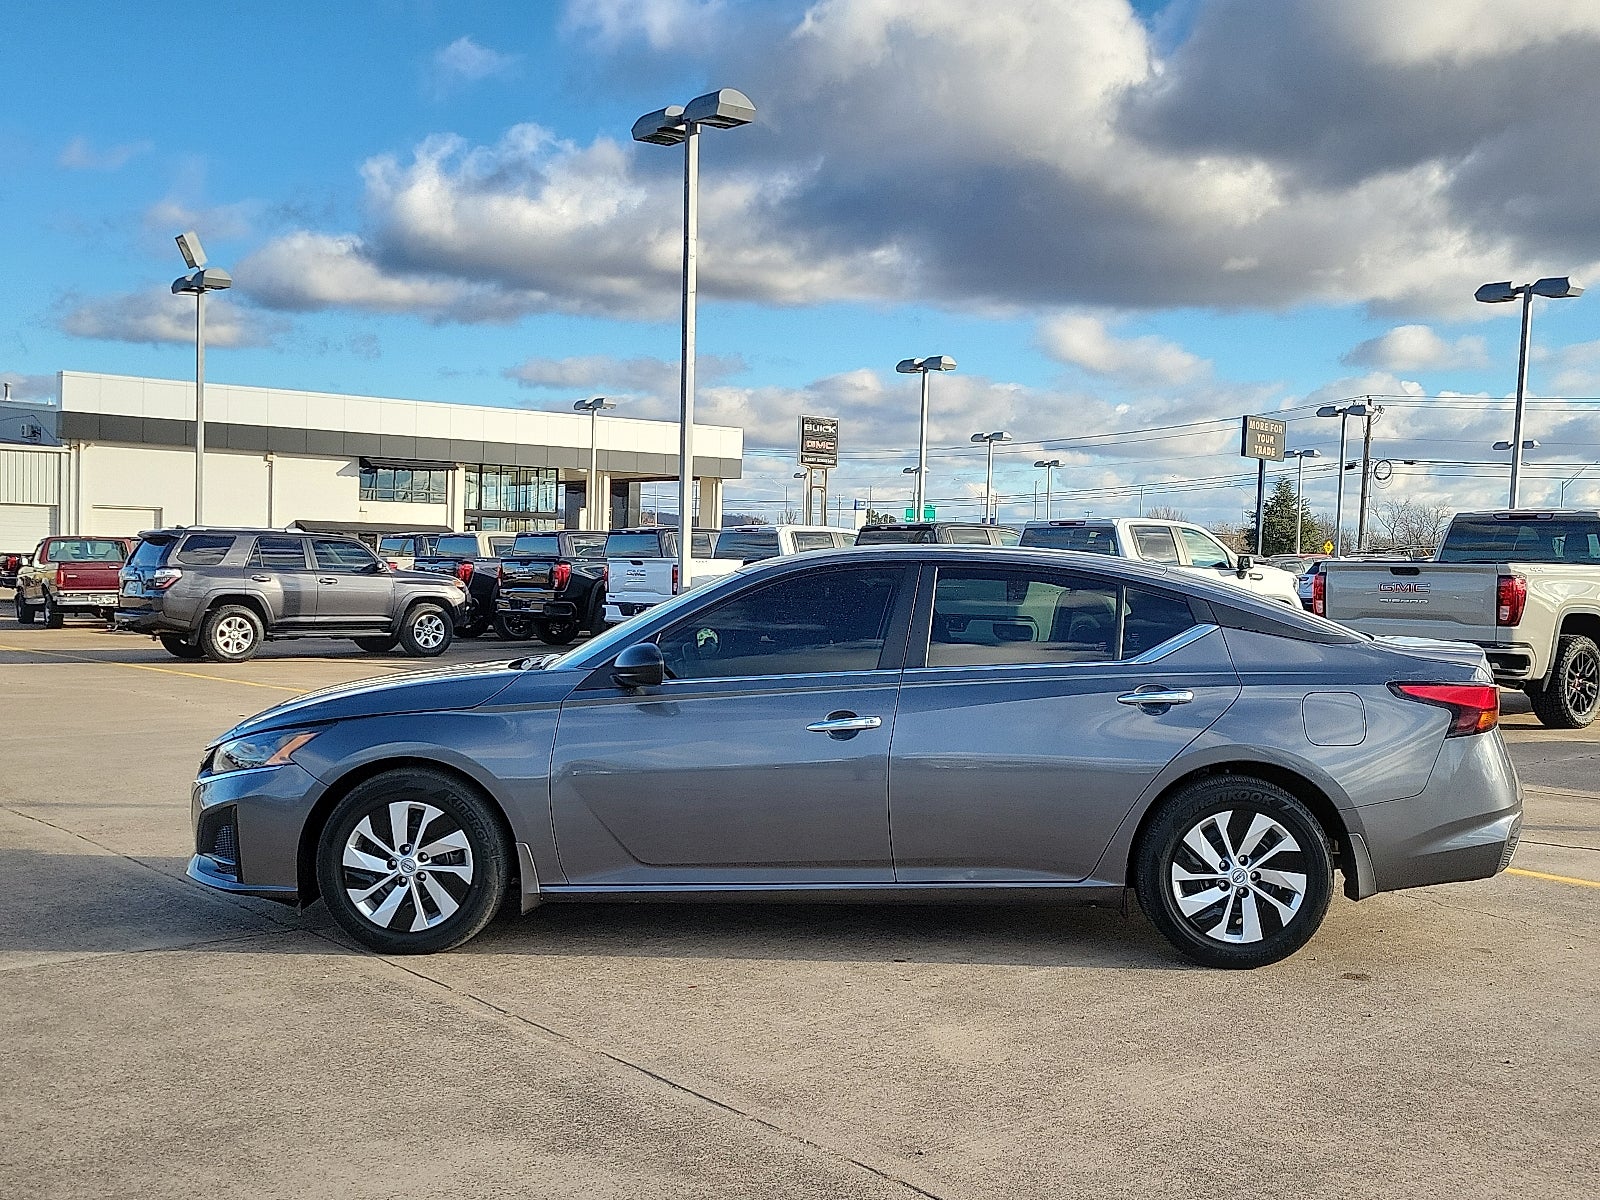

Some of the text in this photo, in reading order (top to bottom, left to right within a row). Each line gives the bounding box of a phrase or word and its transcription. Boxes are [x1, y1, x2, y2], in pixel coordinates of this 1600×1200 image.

[804, 423, 836, 433] BUICK
[1249, 420, 1283, 434] MORE FOR
[1257, 433, 1275, 444] YOUR
[805, 440, 835, 450] GMC
[1254, 445, 1276, 456] TRADE
[1378, 582, 1431, 594] GMC
